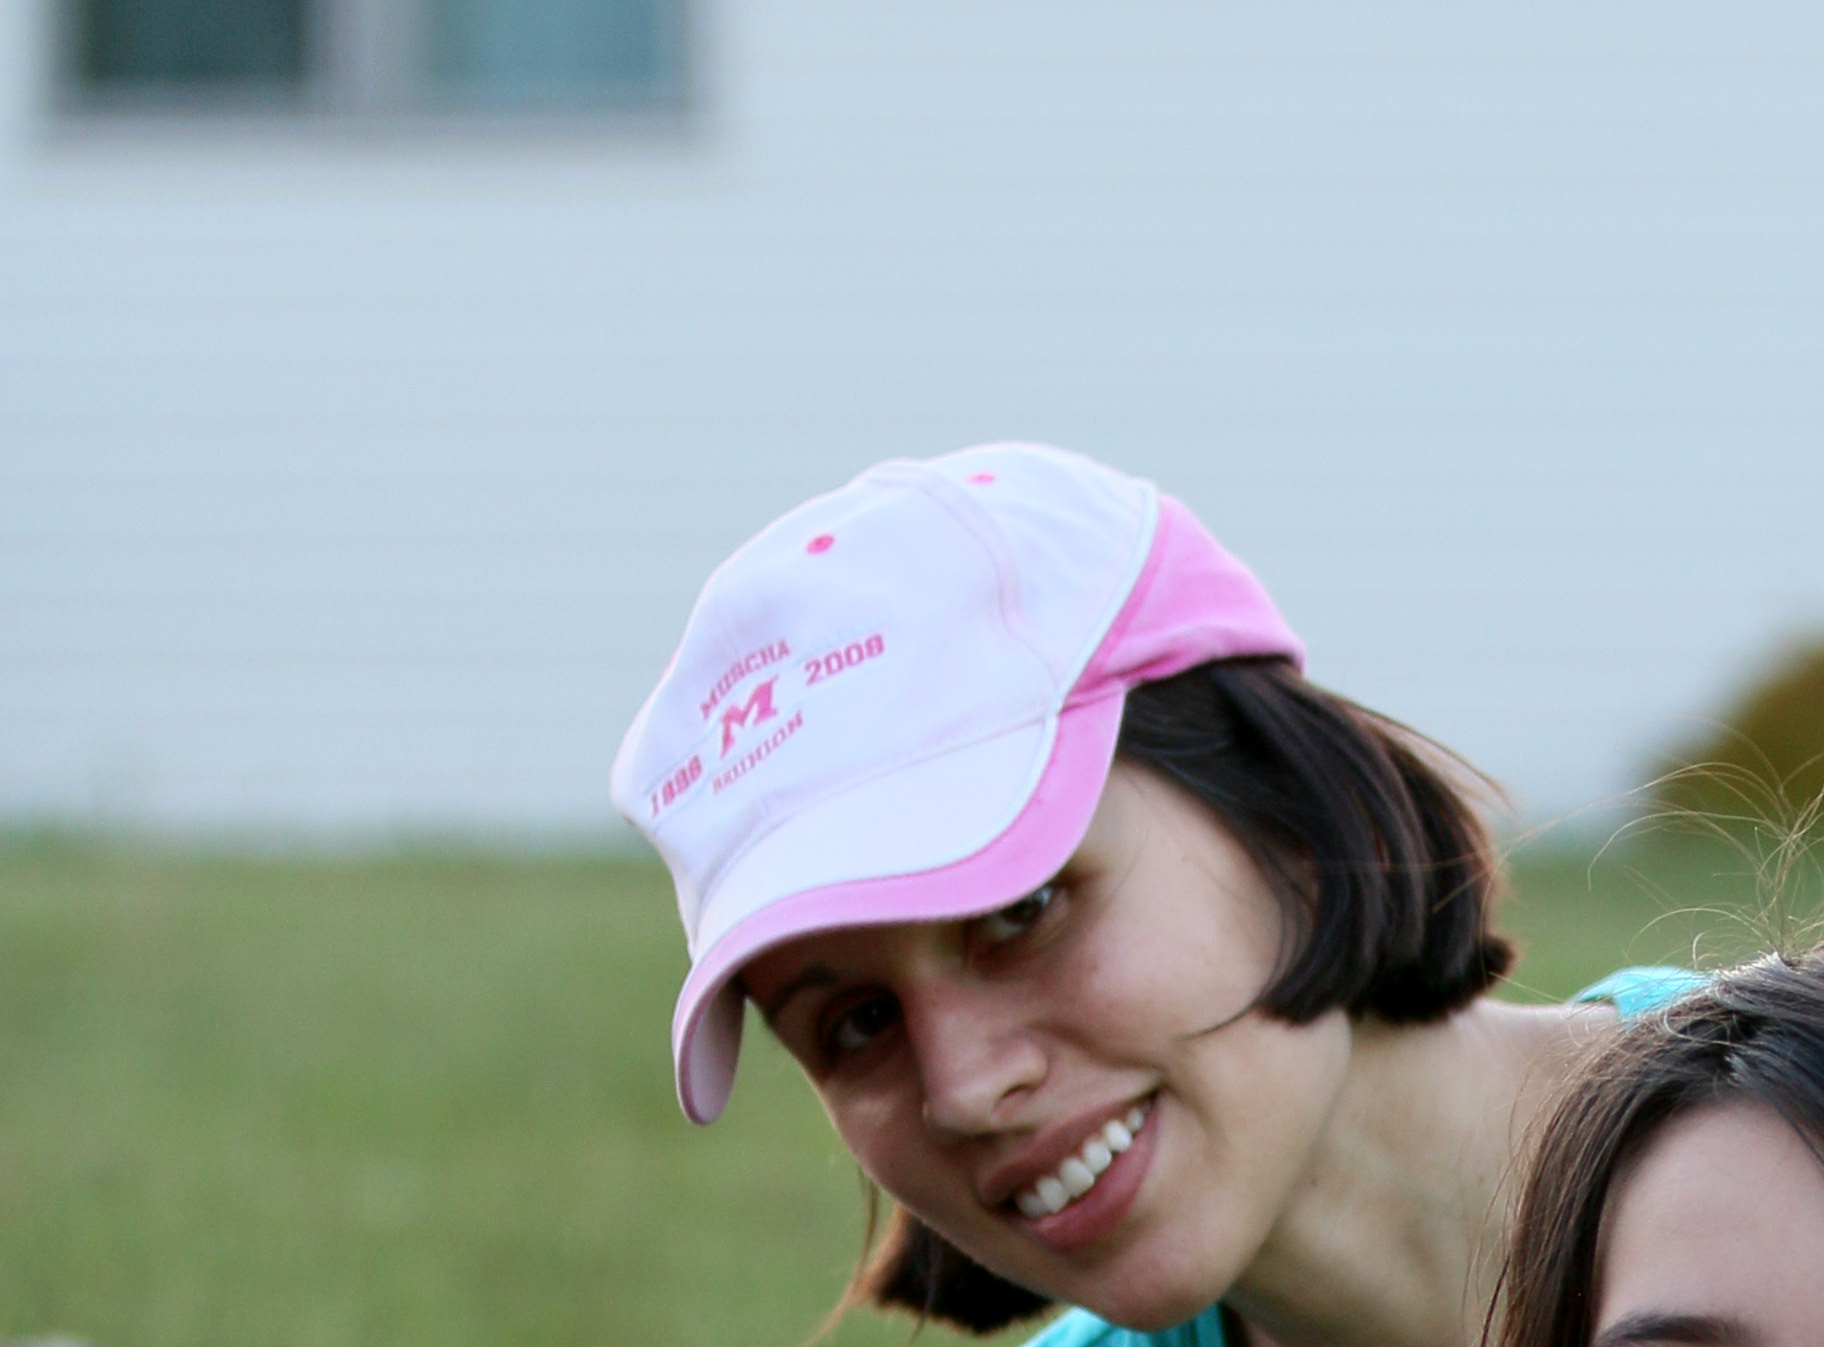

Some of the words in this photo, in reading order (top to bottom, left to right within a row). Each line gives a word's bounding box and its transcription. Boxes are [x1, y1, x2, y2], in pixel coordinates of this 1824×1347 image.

[700, 640, 790, 720] MUSCHA
[720, 674, 779, 759] M
[804, 634, 884, 687] 2008
[712, 708, 803, 796] REUNION
